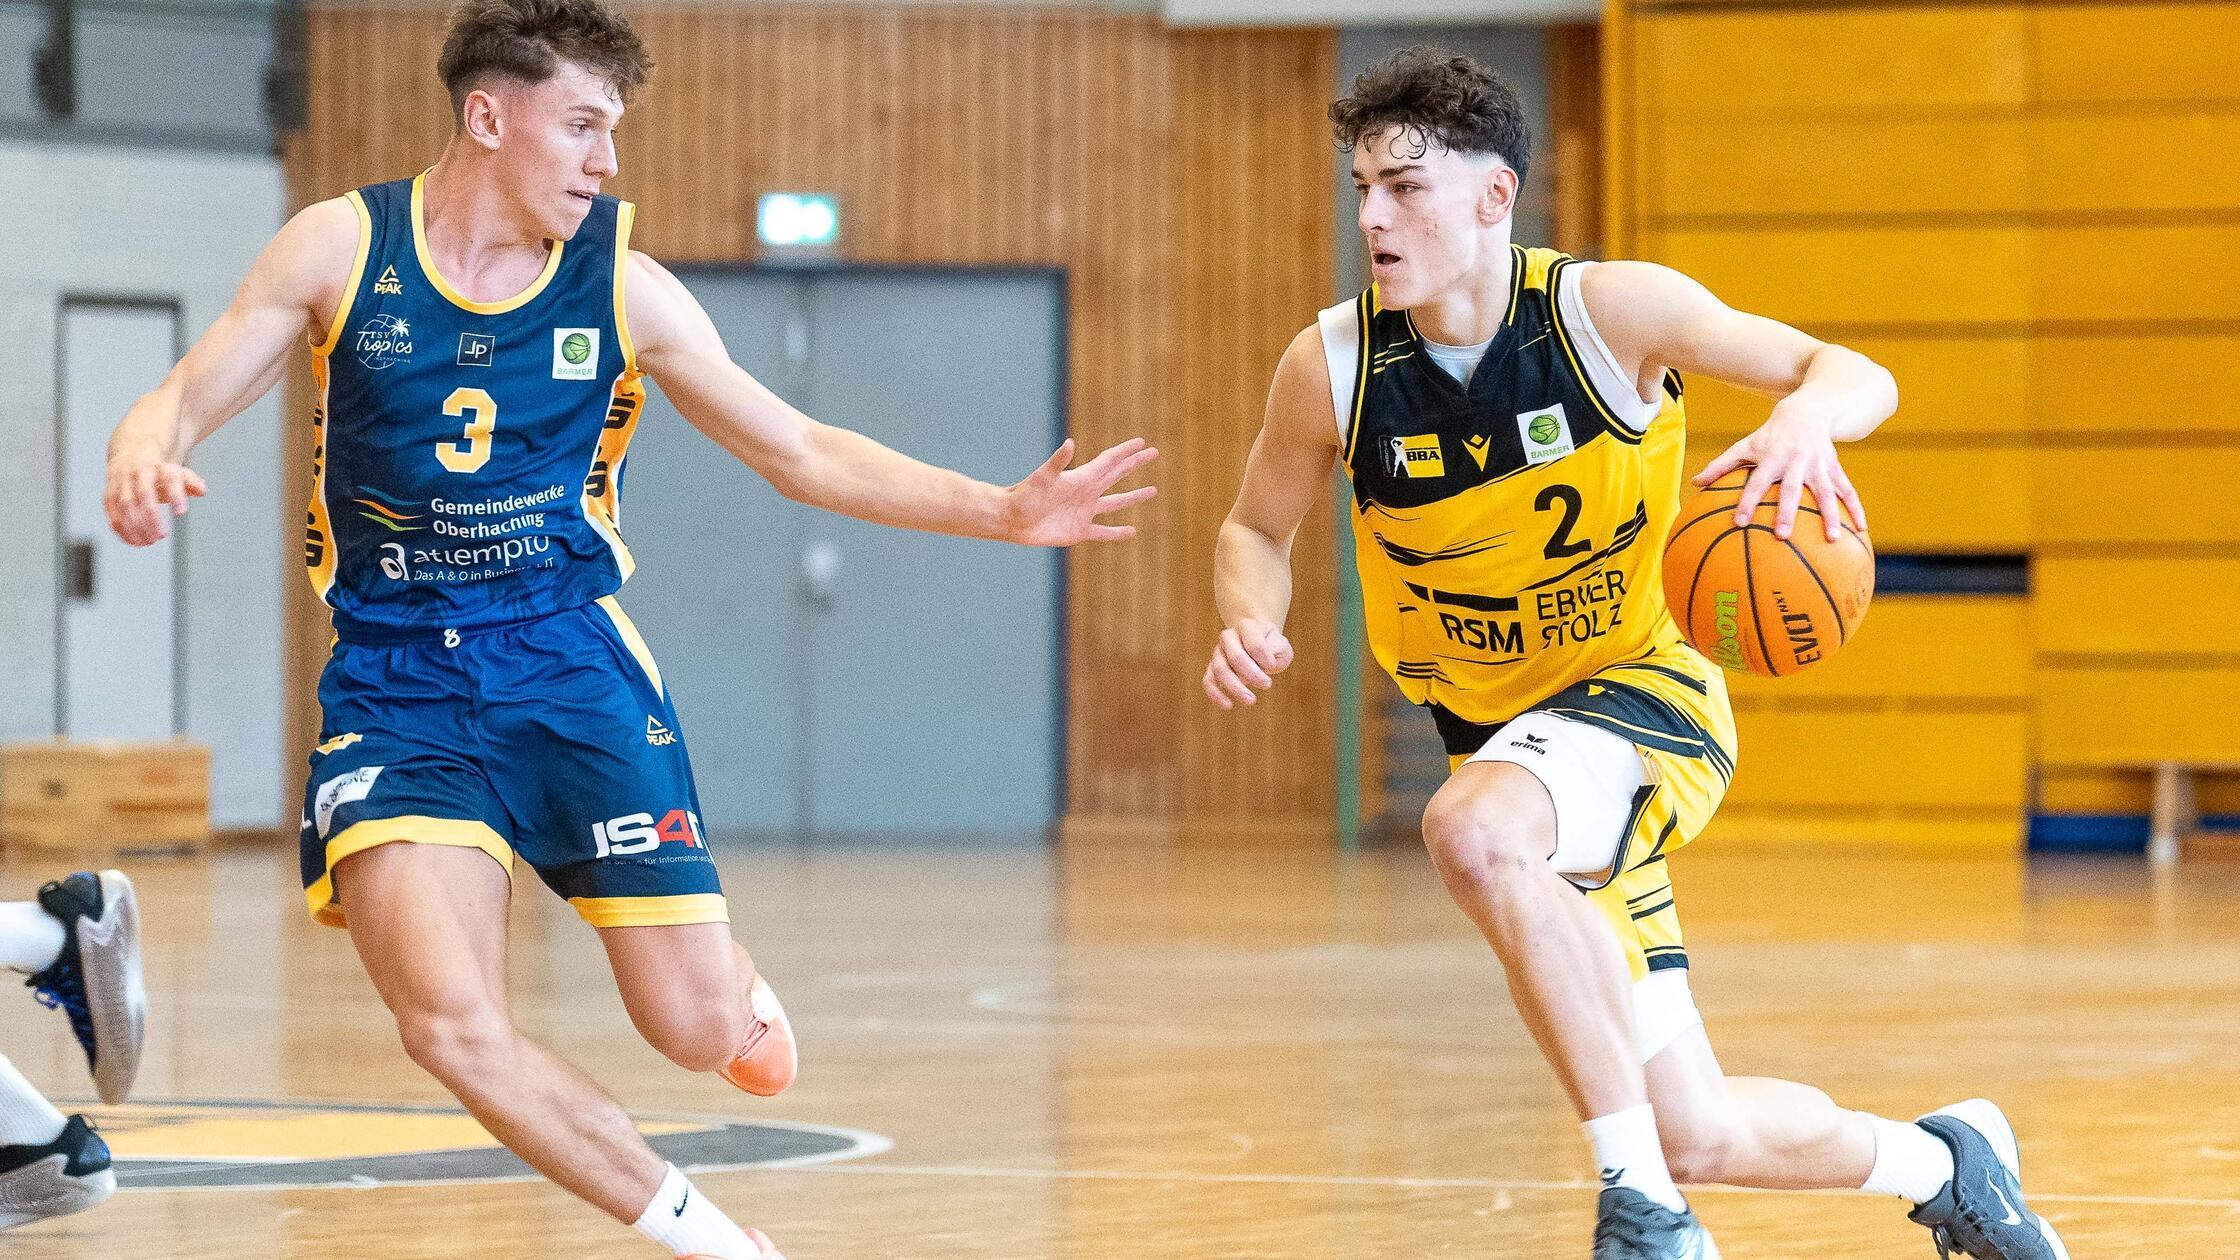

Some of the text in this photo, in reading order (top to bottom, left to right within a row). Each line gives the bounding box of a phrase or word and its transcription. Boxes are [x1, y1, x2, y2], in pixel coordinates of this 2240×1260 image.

[374, 283, 402, 295] PEAK
[356, 331, 413, 357] Tropics
[369, 331, 391, 339] TSV
[557, 367, 593, 376] BARMER
[435, 387, 498, 473] 3
[1530, 445, 1570, 459] BARMER
[431, 484, 565, 516] Gemeindewerke
[433, 512, 546, 539] Oberhaching
[1534, 484, 1593, 561] 2
[414, 570, 434, 581] Das
[436, 571, 445, 581] A
[447, 571, 457, 581] &
[459, 571, 469, 581] O
[471, 570, 481, 581] in
[545, 557, 554, 568] IT
[1438, 612, 1525, 654] RSM
[1541, 603, 1622, 650] STOLZ
[646, 731, 677, 746] PEAK
[1510, 741, 1546, 755] erima
[644, 856, 657, 866] für
